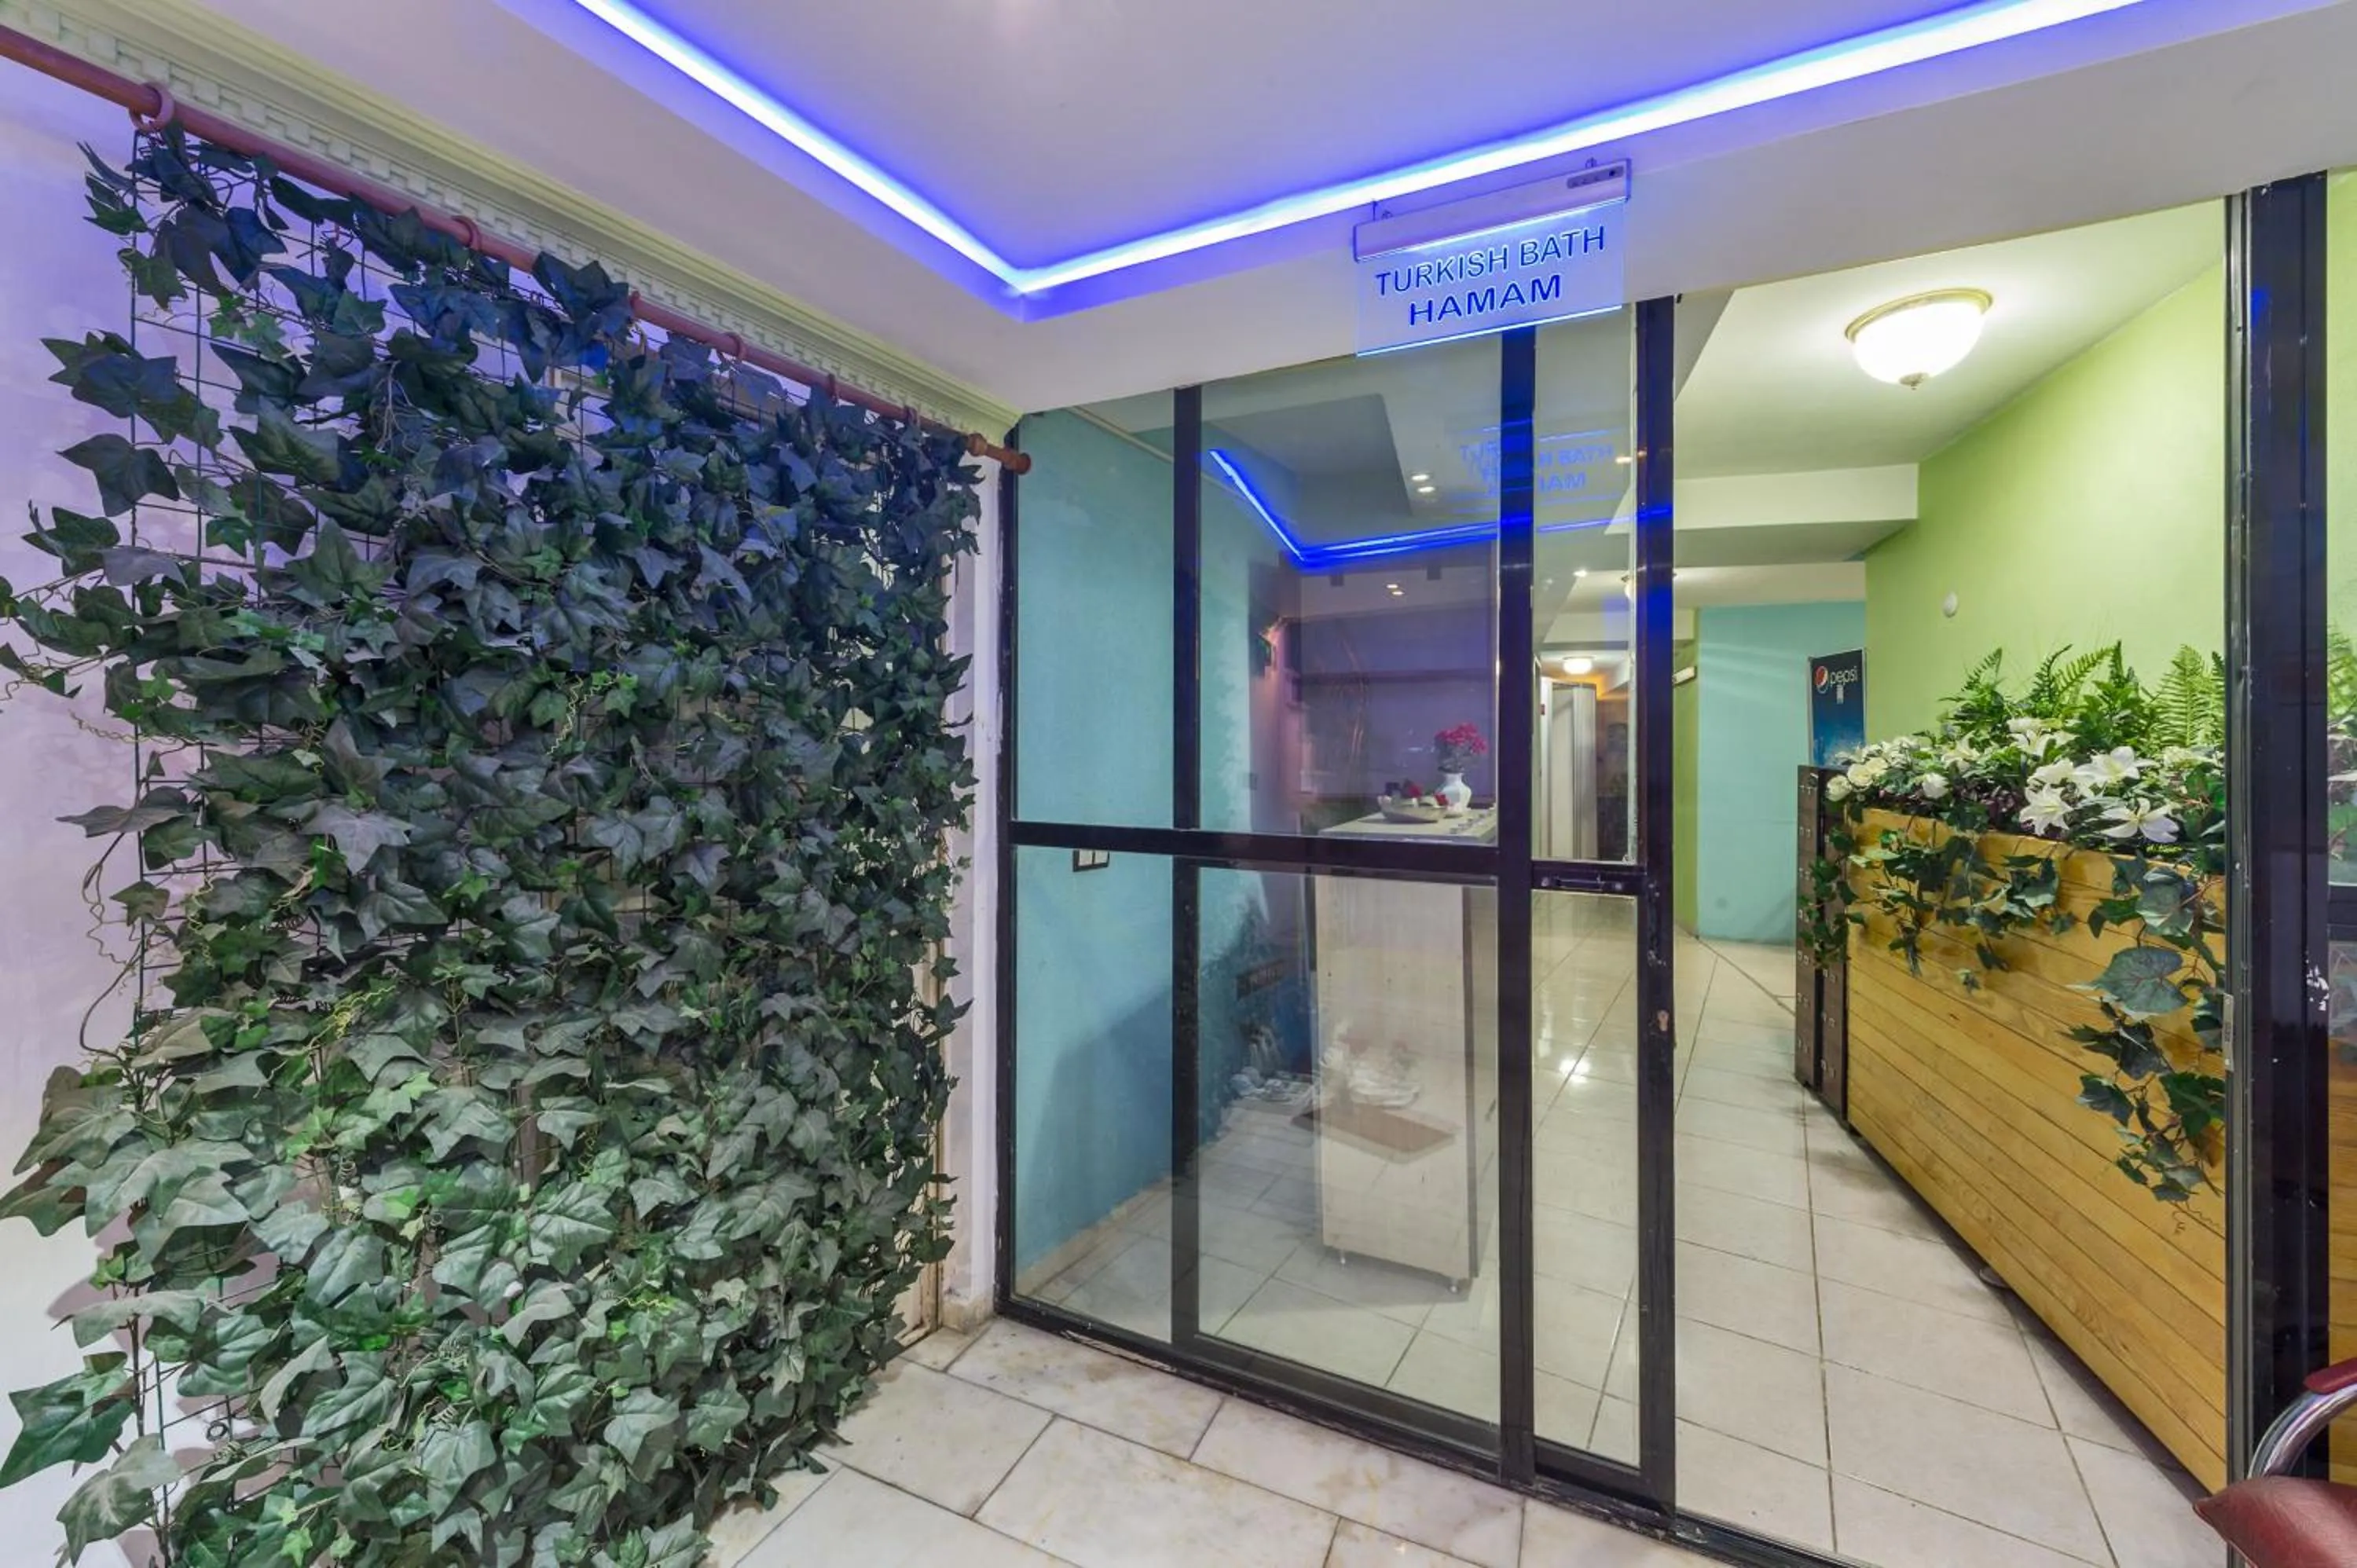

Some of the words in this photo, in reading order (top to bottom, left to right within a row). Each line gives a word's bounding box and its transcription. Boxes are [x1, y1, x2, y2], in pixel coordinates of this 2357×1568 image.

[1376, 247, 1508, 296] TURKISH
[1520, 225, 1605, 266] BATH
[1409, 274, 1561, 326] HAMAM
[1831, 666, 1858, 687] pepsi
